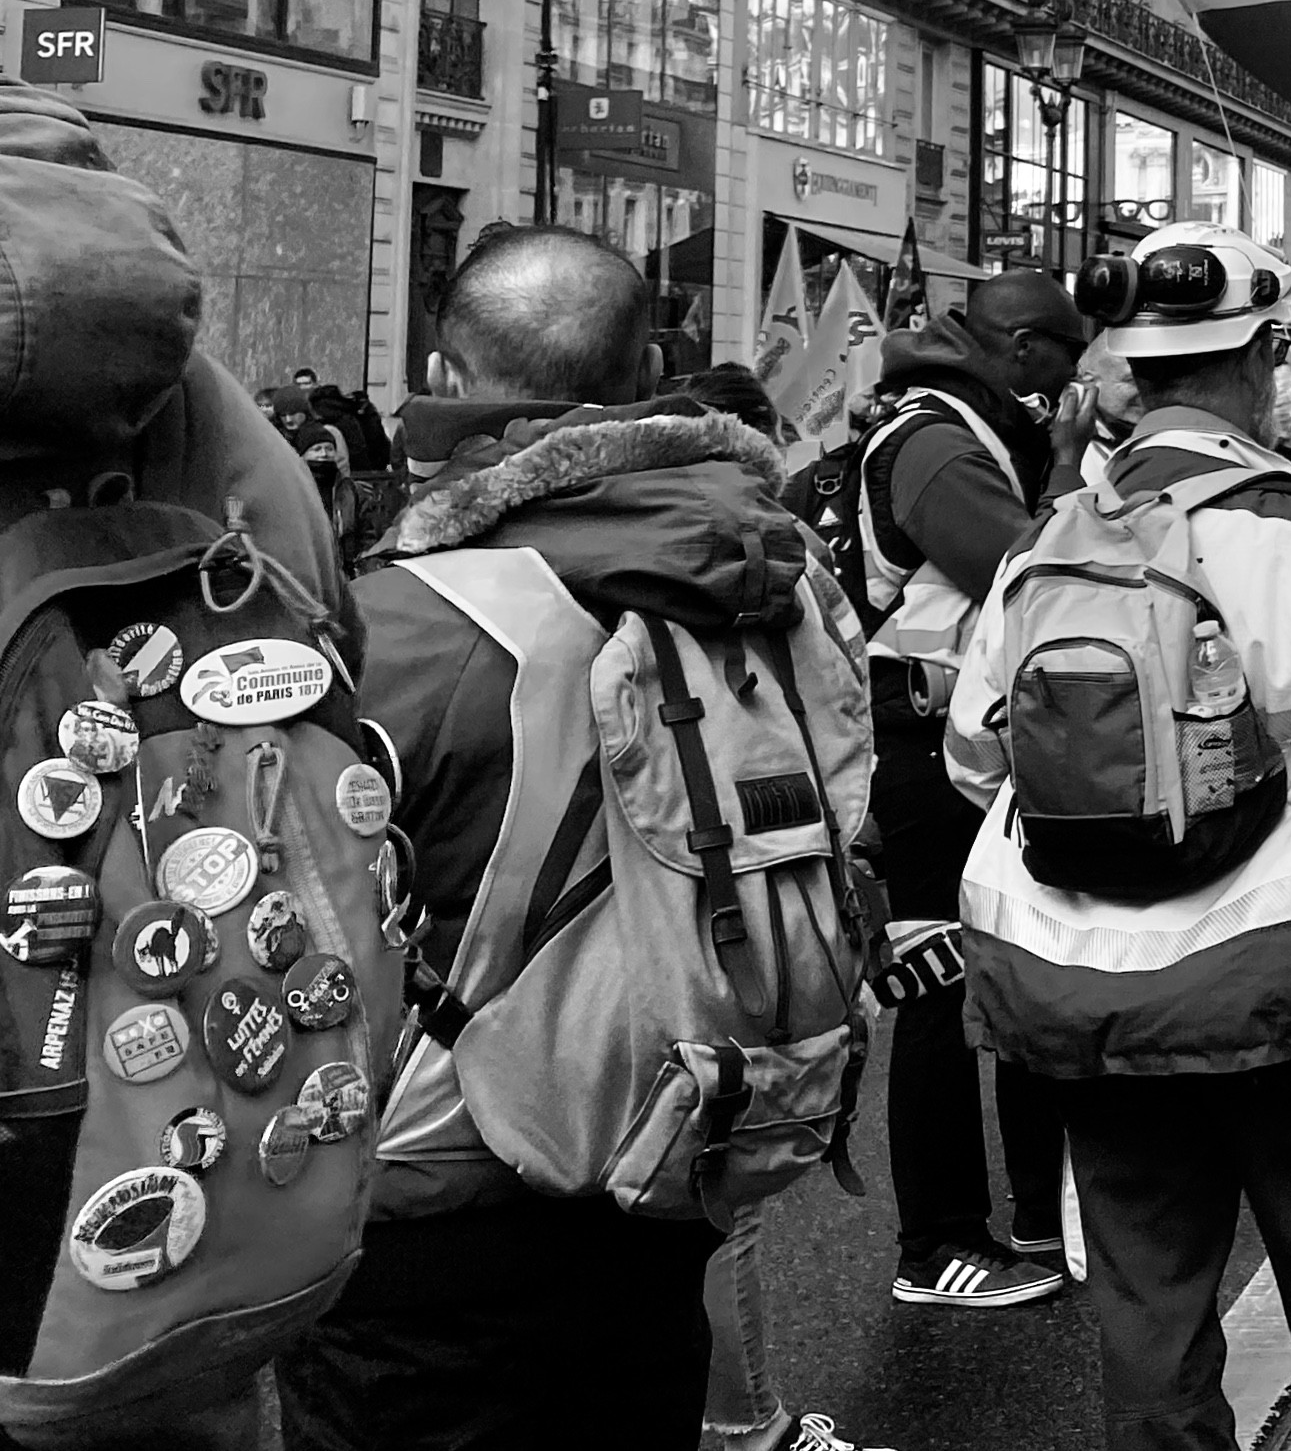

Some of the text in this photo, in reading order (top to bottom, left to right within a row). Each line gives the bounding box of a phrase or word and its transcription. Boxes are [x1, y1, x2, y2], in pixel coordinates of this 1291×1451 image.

[37, 31, 95, 58] SFR
[199, 60, 268, 120] SFR
[236, 667, 324, 692] Commune
[236, 684, 324, 706] de PARIS 1871
[40, 989, 76, 1070] ARPENAZ
[226, 997, 268, 1051] LUTTES
